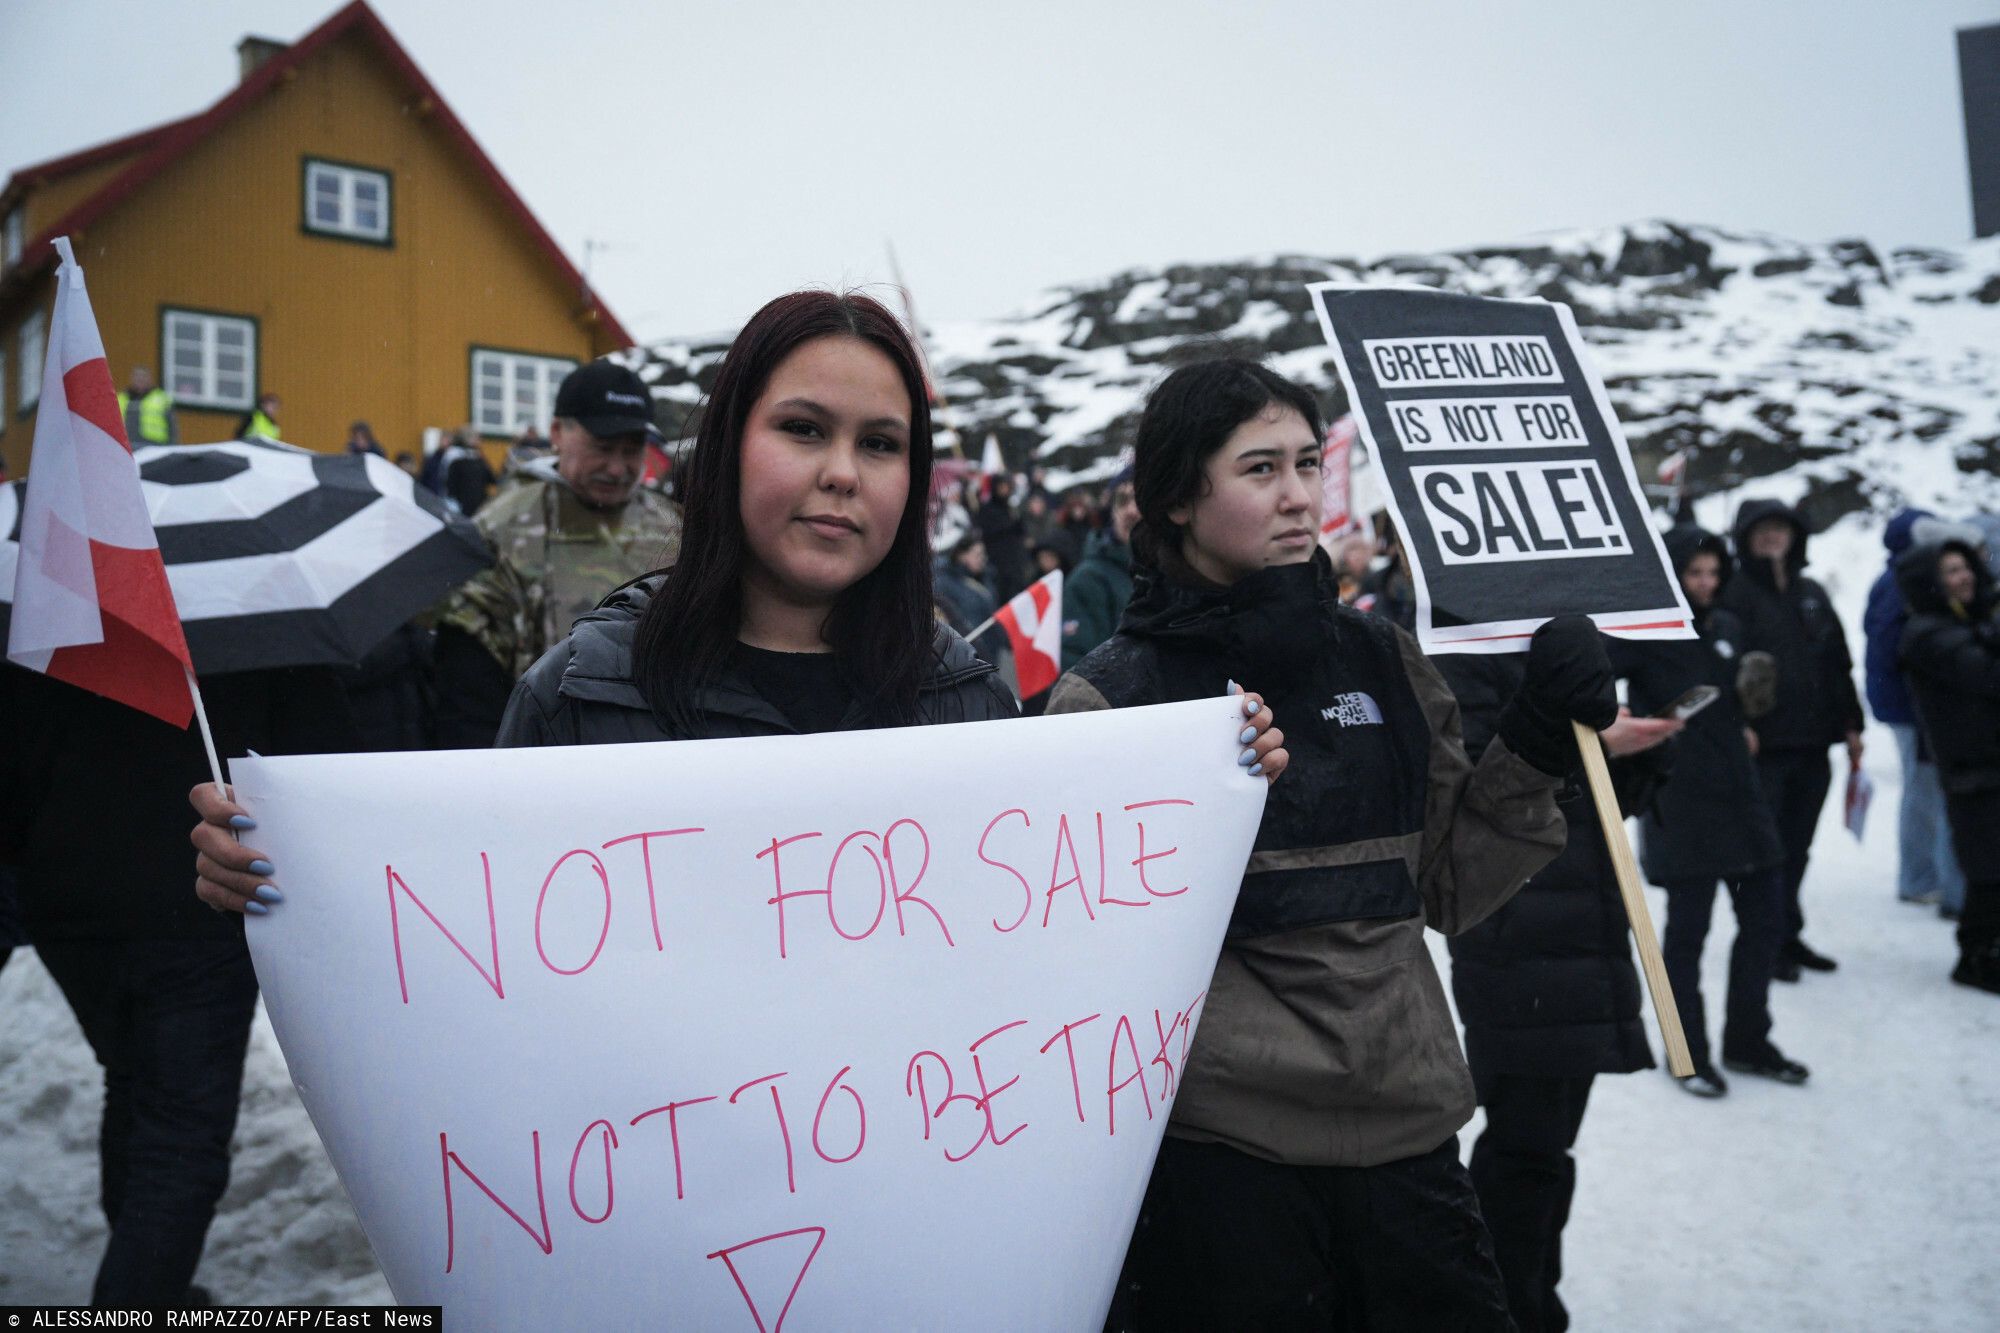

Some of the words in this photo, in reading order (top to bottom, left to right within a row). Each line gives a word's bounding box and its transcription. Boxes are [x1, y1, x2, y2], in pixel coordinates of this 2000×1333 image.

[1373, 342, 1554, 382] GREENLAND
[1395, 406, 1431, 444] IS
[1443, 404, 1504, 442] NOT
[1519, 403, 1579, 440] FOR
[1424, 467, 1623, 557] SALE!
[1320, 702, 1365, 720] NORTH
[1334, 692, 1360, 705] THE
[1339, 713, 1369, 728] FACE
[386, 827, 705, 1005] NOT
[756, 818, 955, 959] FOR
[978, 799, 1195, 933] SALE
[440, 1095, 718, 1274] NOT
[729, 1065, 866, 1193] TO
[906, 1019, 1028, 1163] BE
